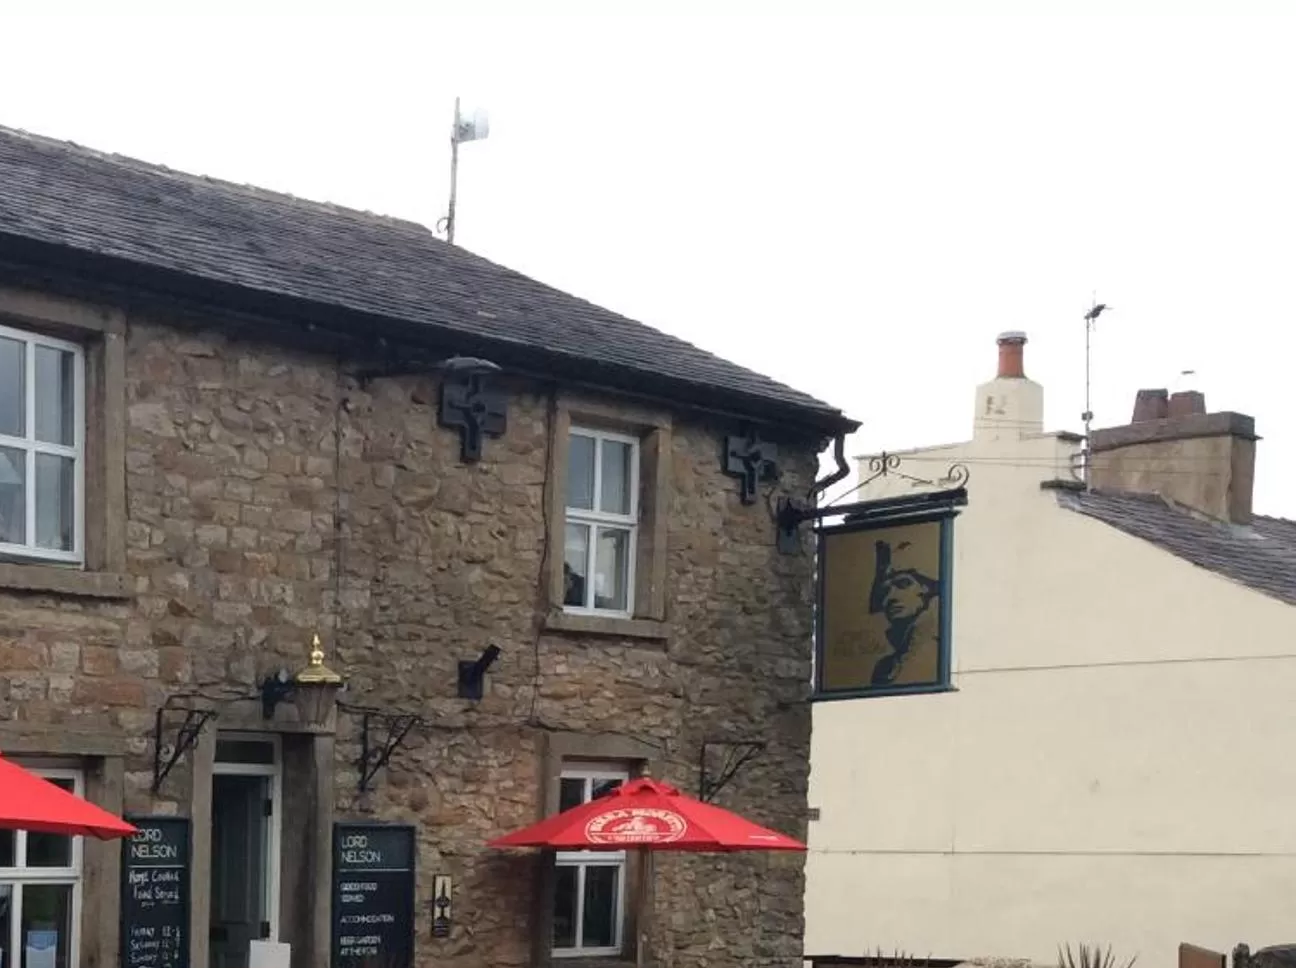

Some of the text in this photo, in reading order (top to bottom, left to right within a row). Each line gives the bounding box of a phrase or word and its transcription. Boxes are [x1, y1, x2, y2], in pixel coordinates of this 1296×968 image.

[132, 828, 162, 842] LORD
[341, 836, 368, 848] LORD
[131, 844, 177, 858] NELSON
[341, 850, 381, 863] NELSON
